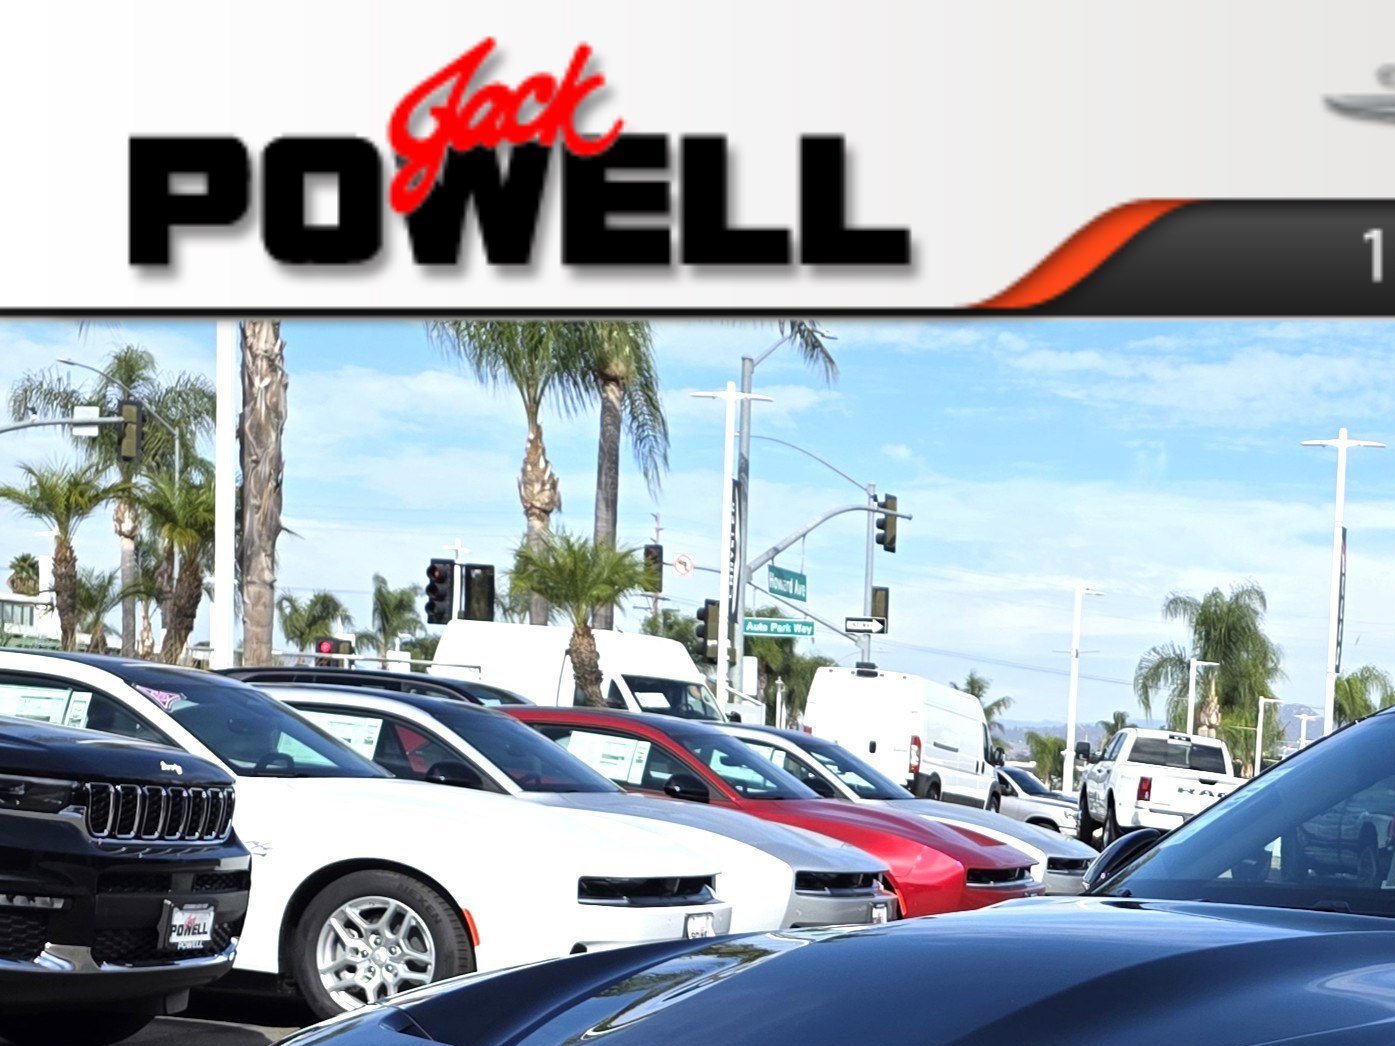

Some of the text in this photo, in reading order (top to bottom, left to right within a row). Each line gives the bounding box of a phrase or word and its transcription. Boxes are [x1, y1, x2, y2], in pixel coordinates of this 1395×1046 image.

[746, 621, 812, 635] Auto Park Way
